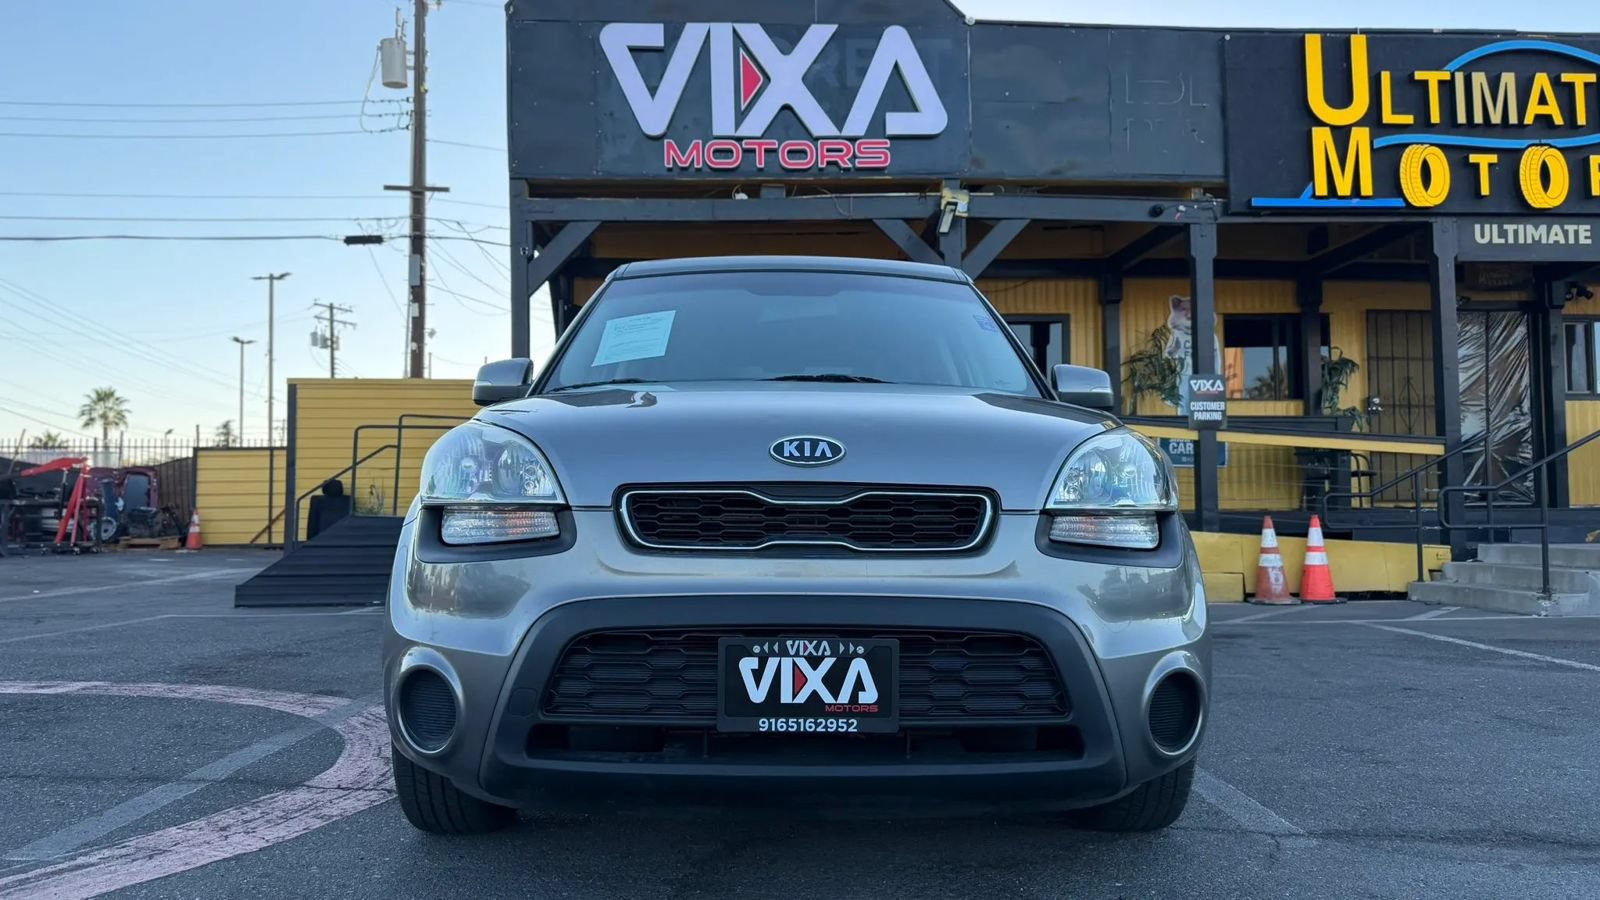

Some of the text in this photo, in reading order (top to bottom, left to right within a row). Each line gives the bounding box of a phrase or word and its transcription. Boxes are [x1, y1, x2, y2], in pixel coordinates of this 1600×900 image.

[600, 22, 948, 137] VIXA
[664, 139, 891, 169] MOTORS
[1474, 224, 1592, 244] ULTIMATE
[1190, 379, 1224, 391] VIXA
[1190, 402, 1225, 410] CUSTOMER
[1194, 412, 1222, 420] PARKING
[783, 440, 833, 458] KIA
[786, 640, 831, 656] VIXA
[738, 657, 879, 703] VIXA
[825, 705, 879, 713] MOTORS
[758, 718, 858, 732] 9165162952
